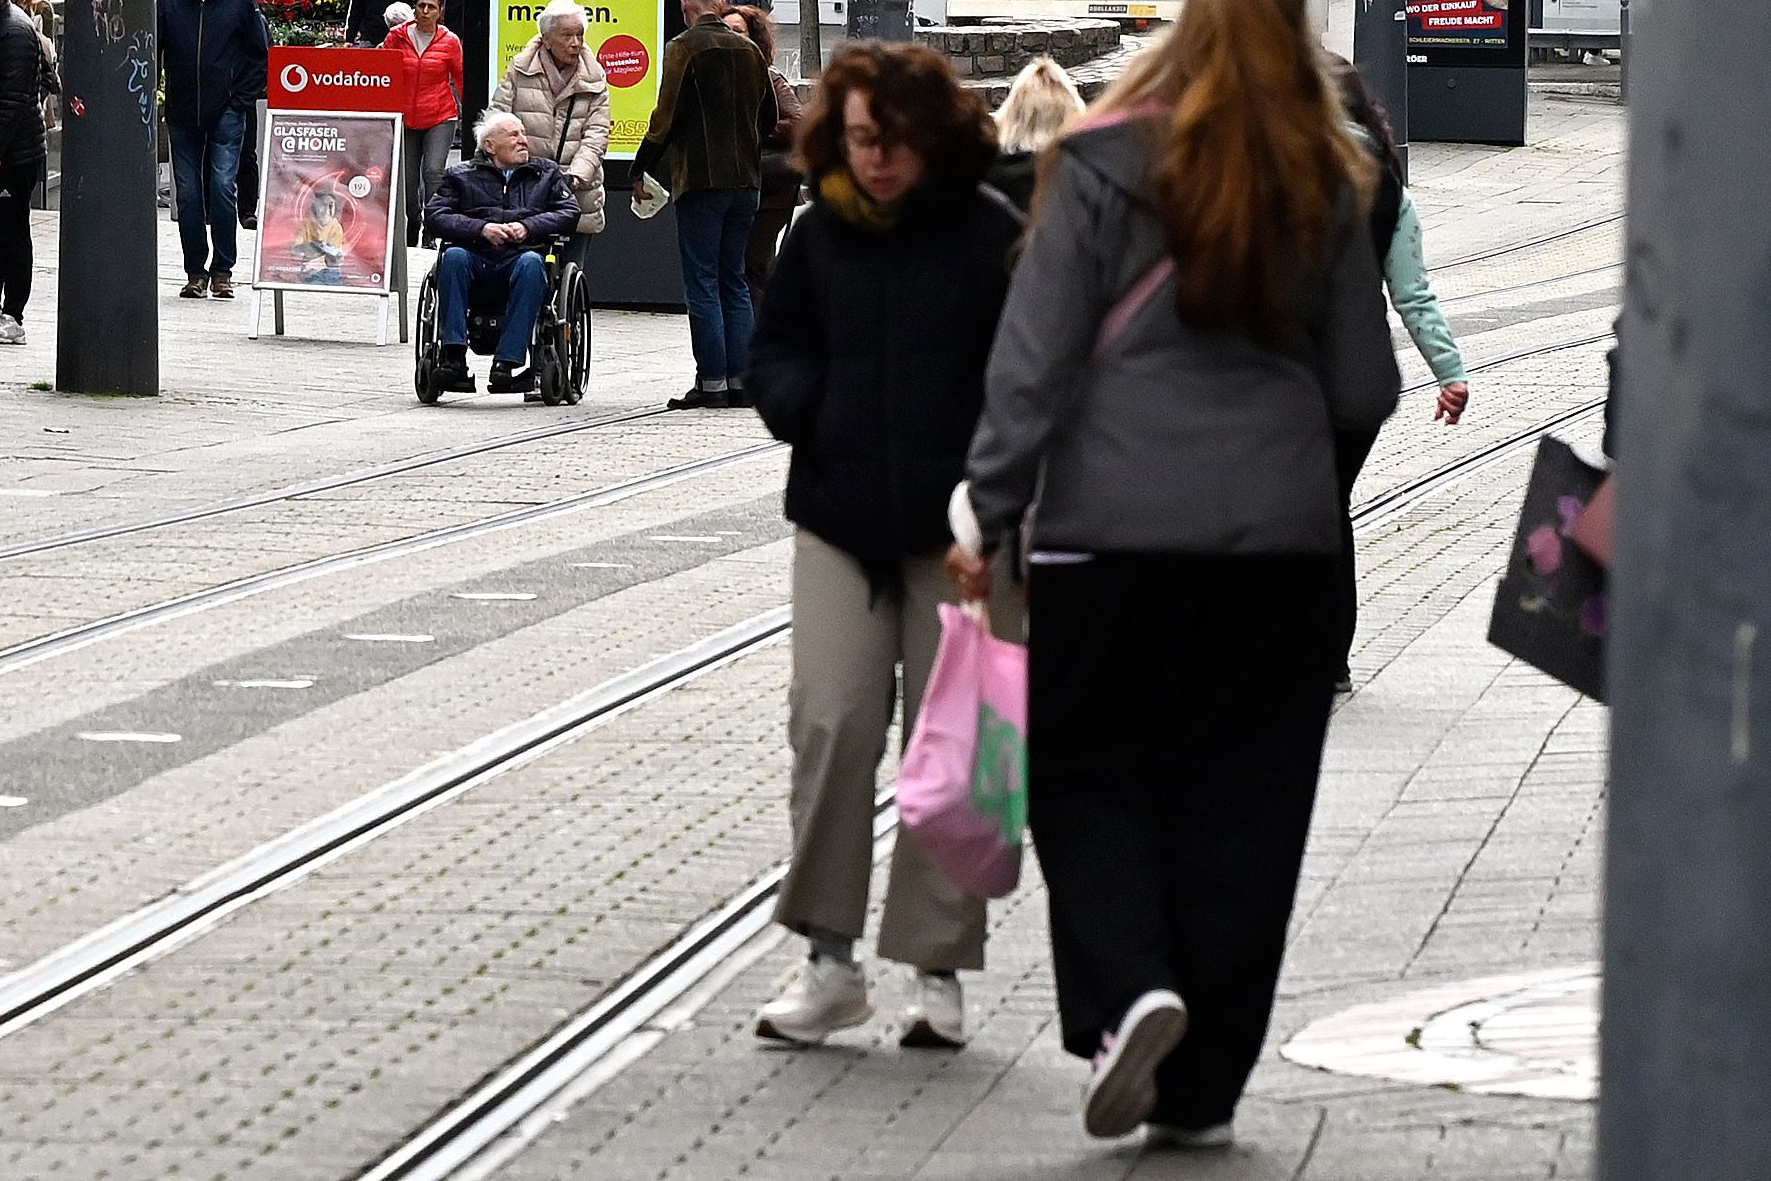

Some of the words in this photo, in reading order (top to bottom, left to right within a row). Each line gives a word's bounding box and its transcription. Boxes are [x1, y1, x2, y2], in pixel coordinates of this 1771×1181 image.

[1421, 4, 1439, 13] DER
[1441, 0, 1477, 11] EINKAUF
[507, 5, 618, 23] maen.
[1428, 17, 1463, 26] FREUDE
[1463, 16, 1495, 25] MACHT
[312, 71, 391, 87] vodafone
[273, 126, 338, 137] GLASFASER
[611, 120, 649, 136] ASB
